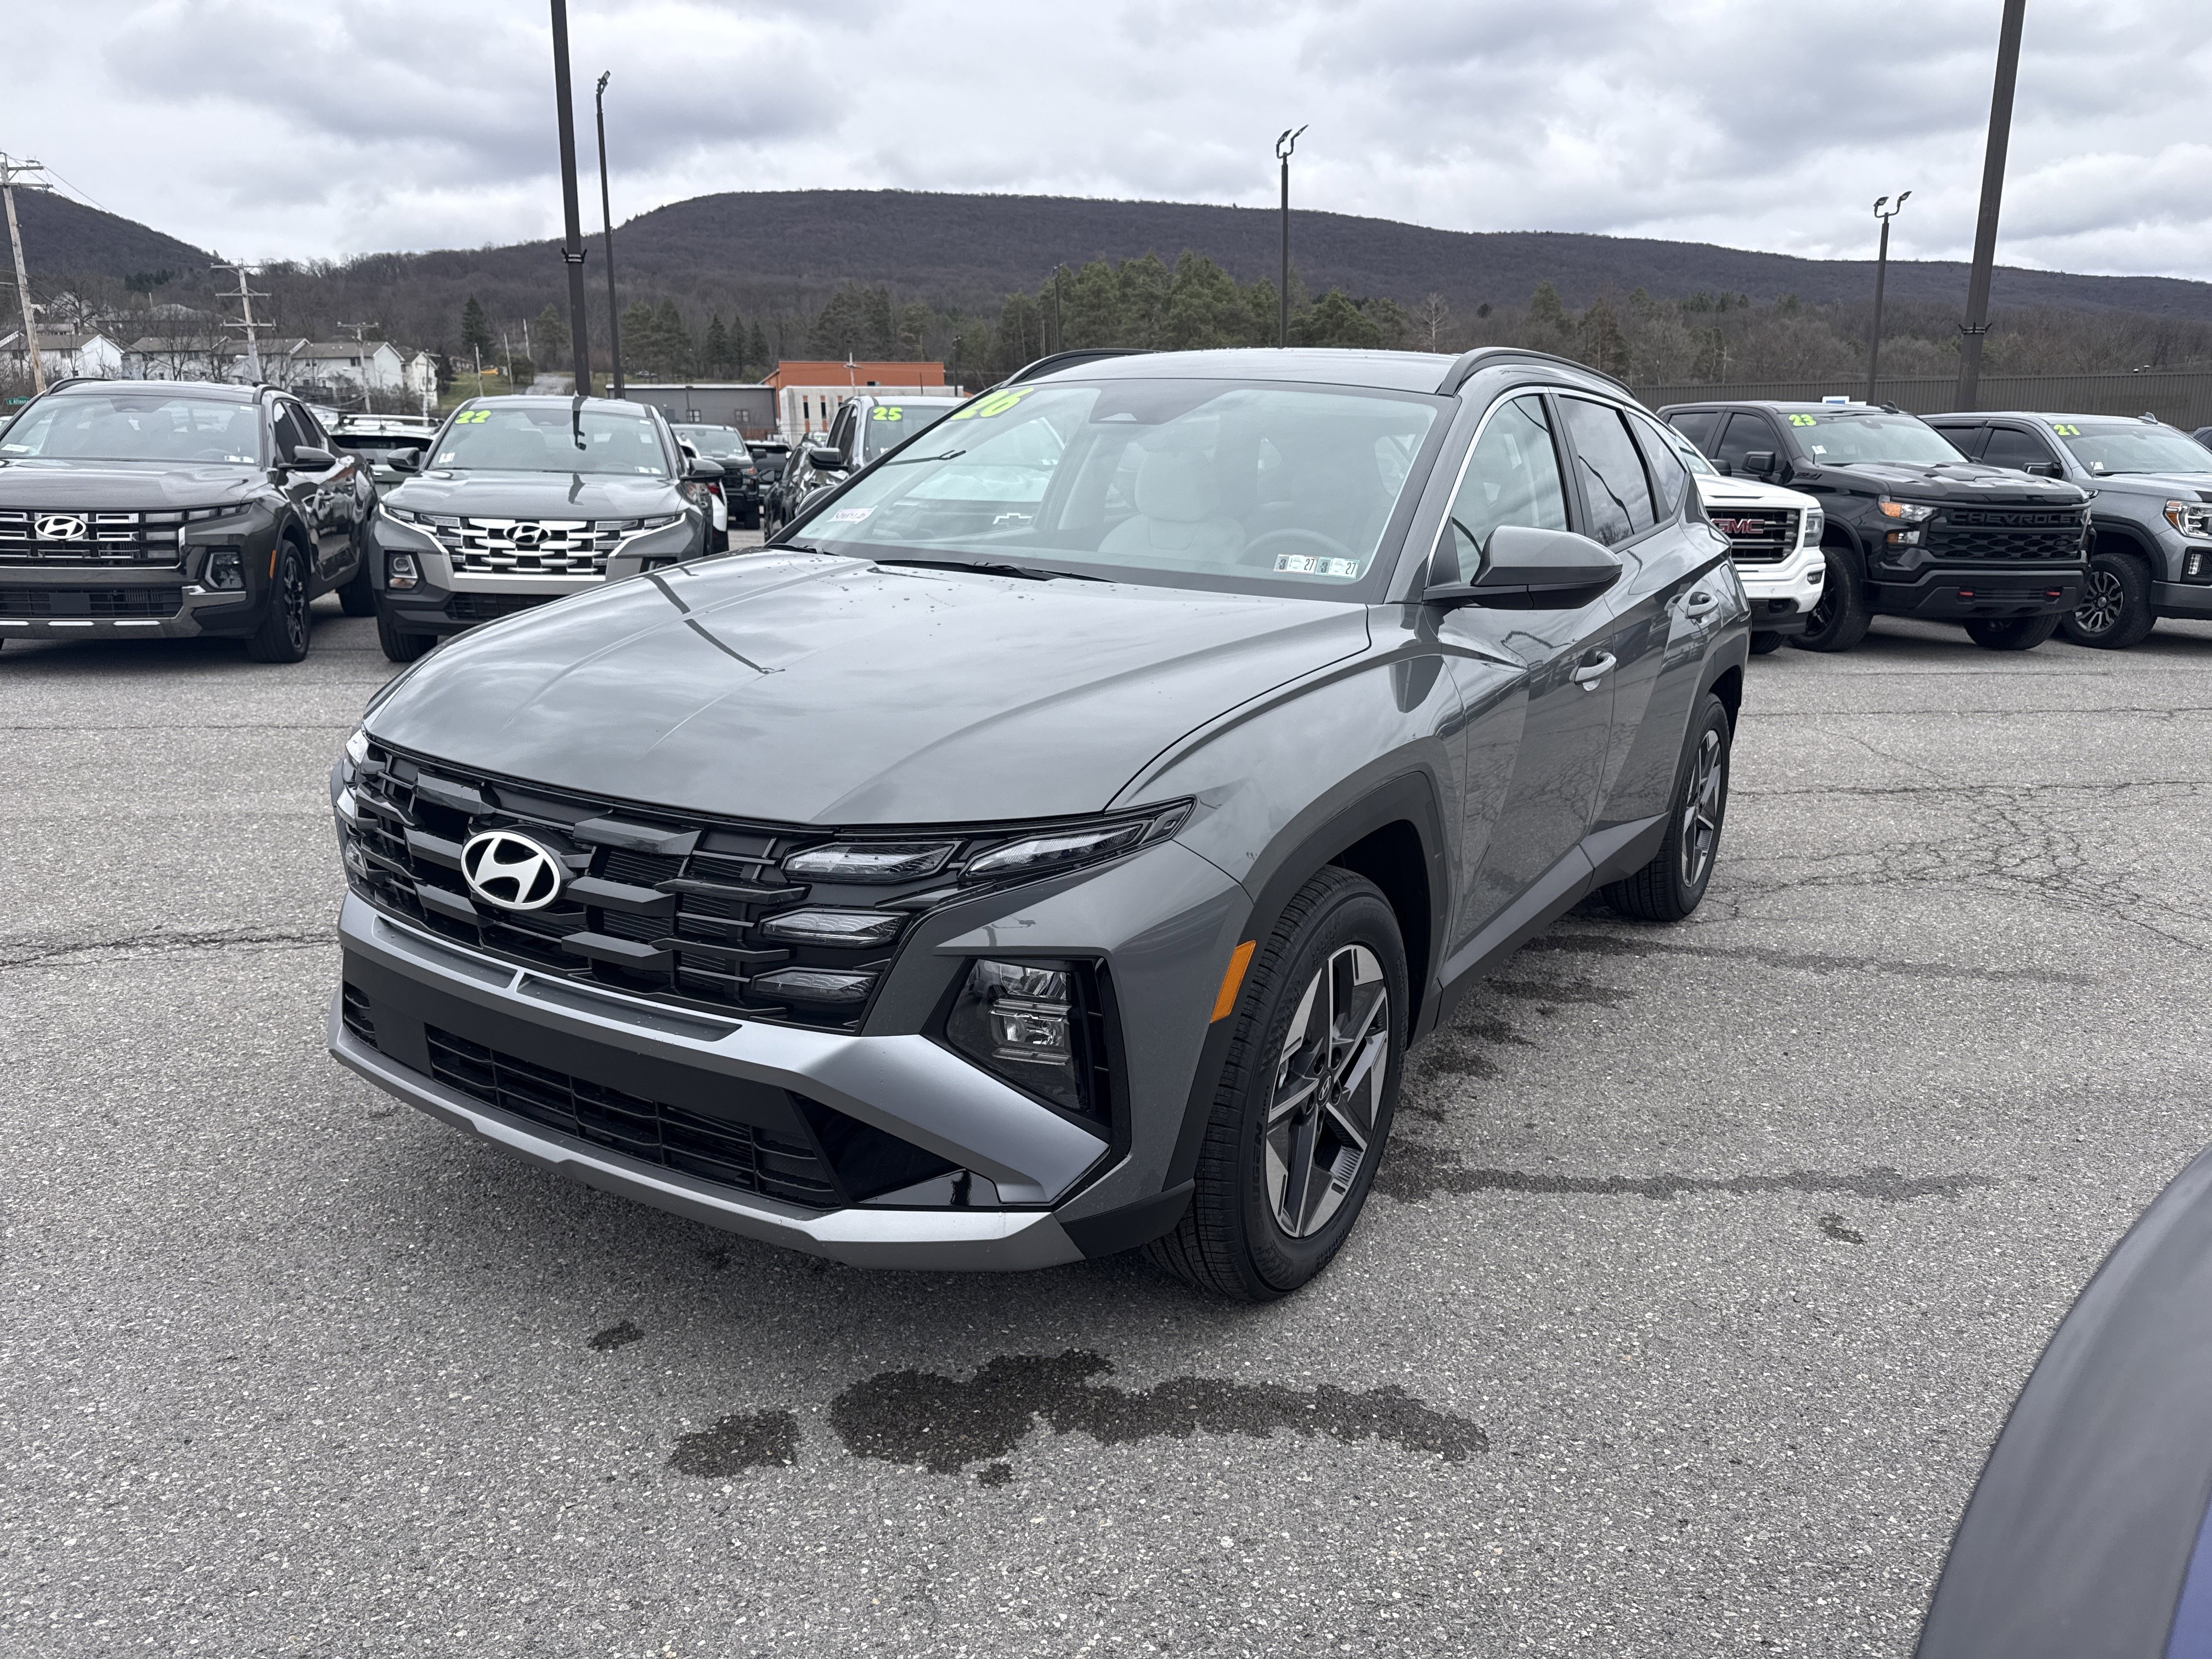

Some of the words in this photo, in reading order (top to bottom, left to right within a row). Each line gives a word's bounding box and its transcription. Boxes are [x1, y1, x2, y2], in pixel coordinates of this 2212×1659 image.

[950, 387, 1034, 421] 26
[455, 410, 492, 424] 22
[873, 407, 903, 421] 25
[1788, 414, 1816, 426] 23
[2053, 424, 2081, 436] 21
[1950, 511, 2081, 524] CHEVROLET
[1711, 518, 1764, 534] GMC
[1304, 558, 1315, 572] 27
[1345, 562, 1356, 575] 27
